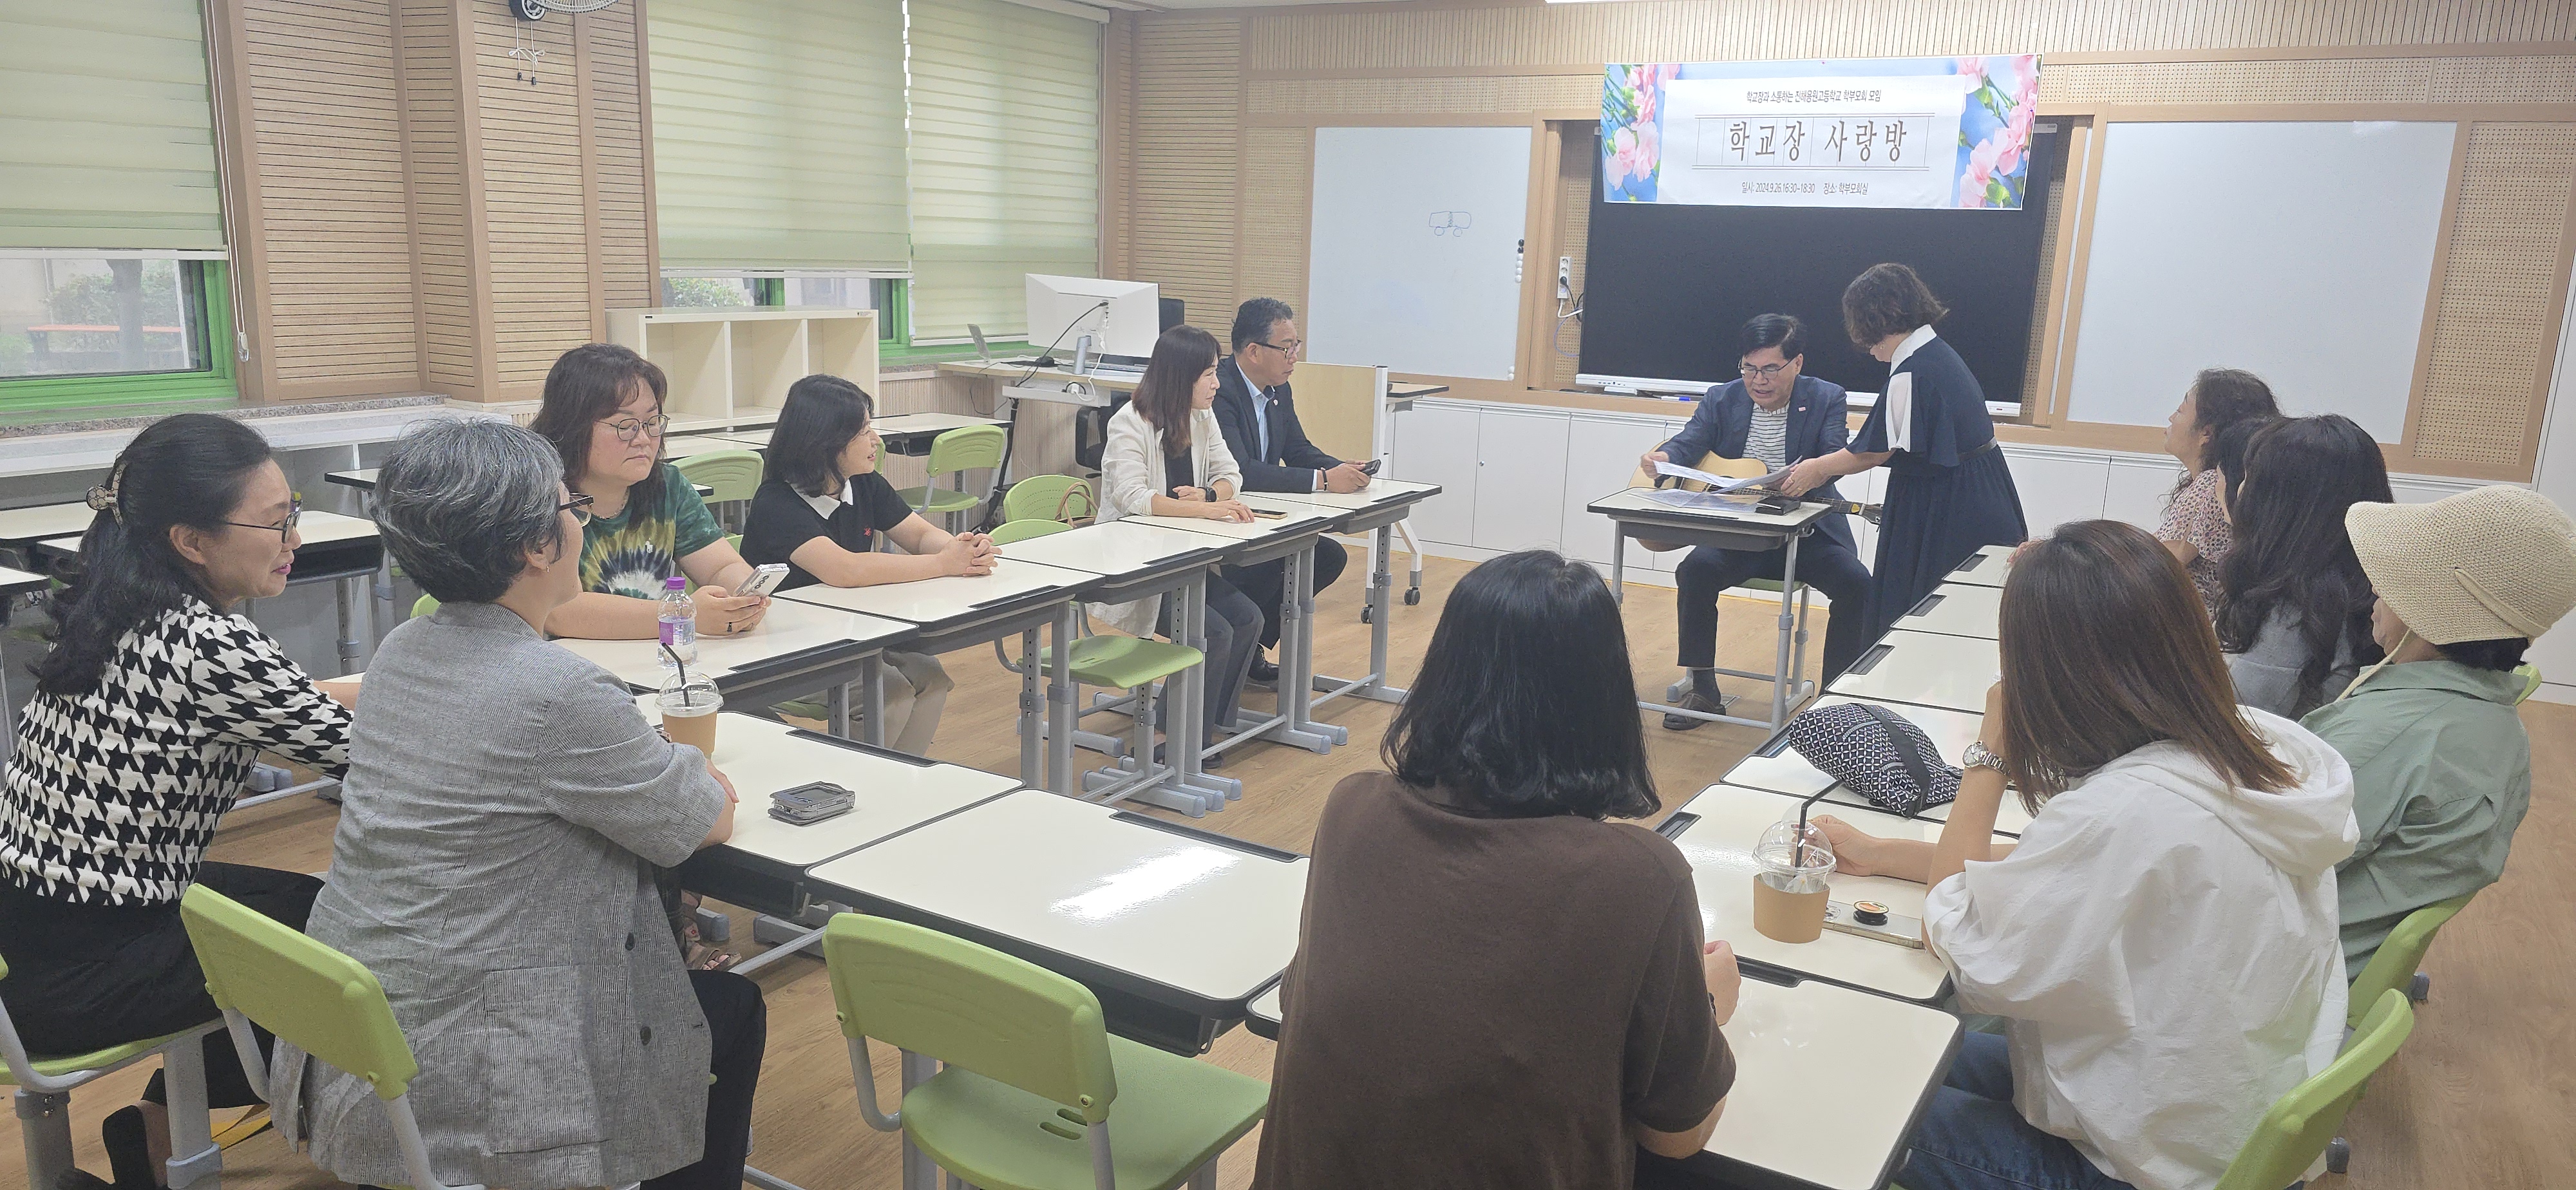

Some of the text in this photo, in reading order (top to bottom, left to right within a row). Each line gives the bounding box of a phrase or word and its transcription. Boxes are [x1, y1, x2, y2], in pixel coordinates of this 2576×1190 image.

[1747, 90, 1882, 103] 학교장과 소통하는 진해용원고등학교 학부모회 모임
[1730, 120, 1907, 162] 학교장 사랑방
[1741, 182, 1754, 194] 일시:
[1823, 182, 1868, 195] 장소: 학부모회실
